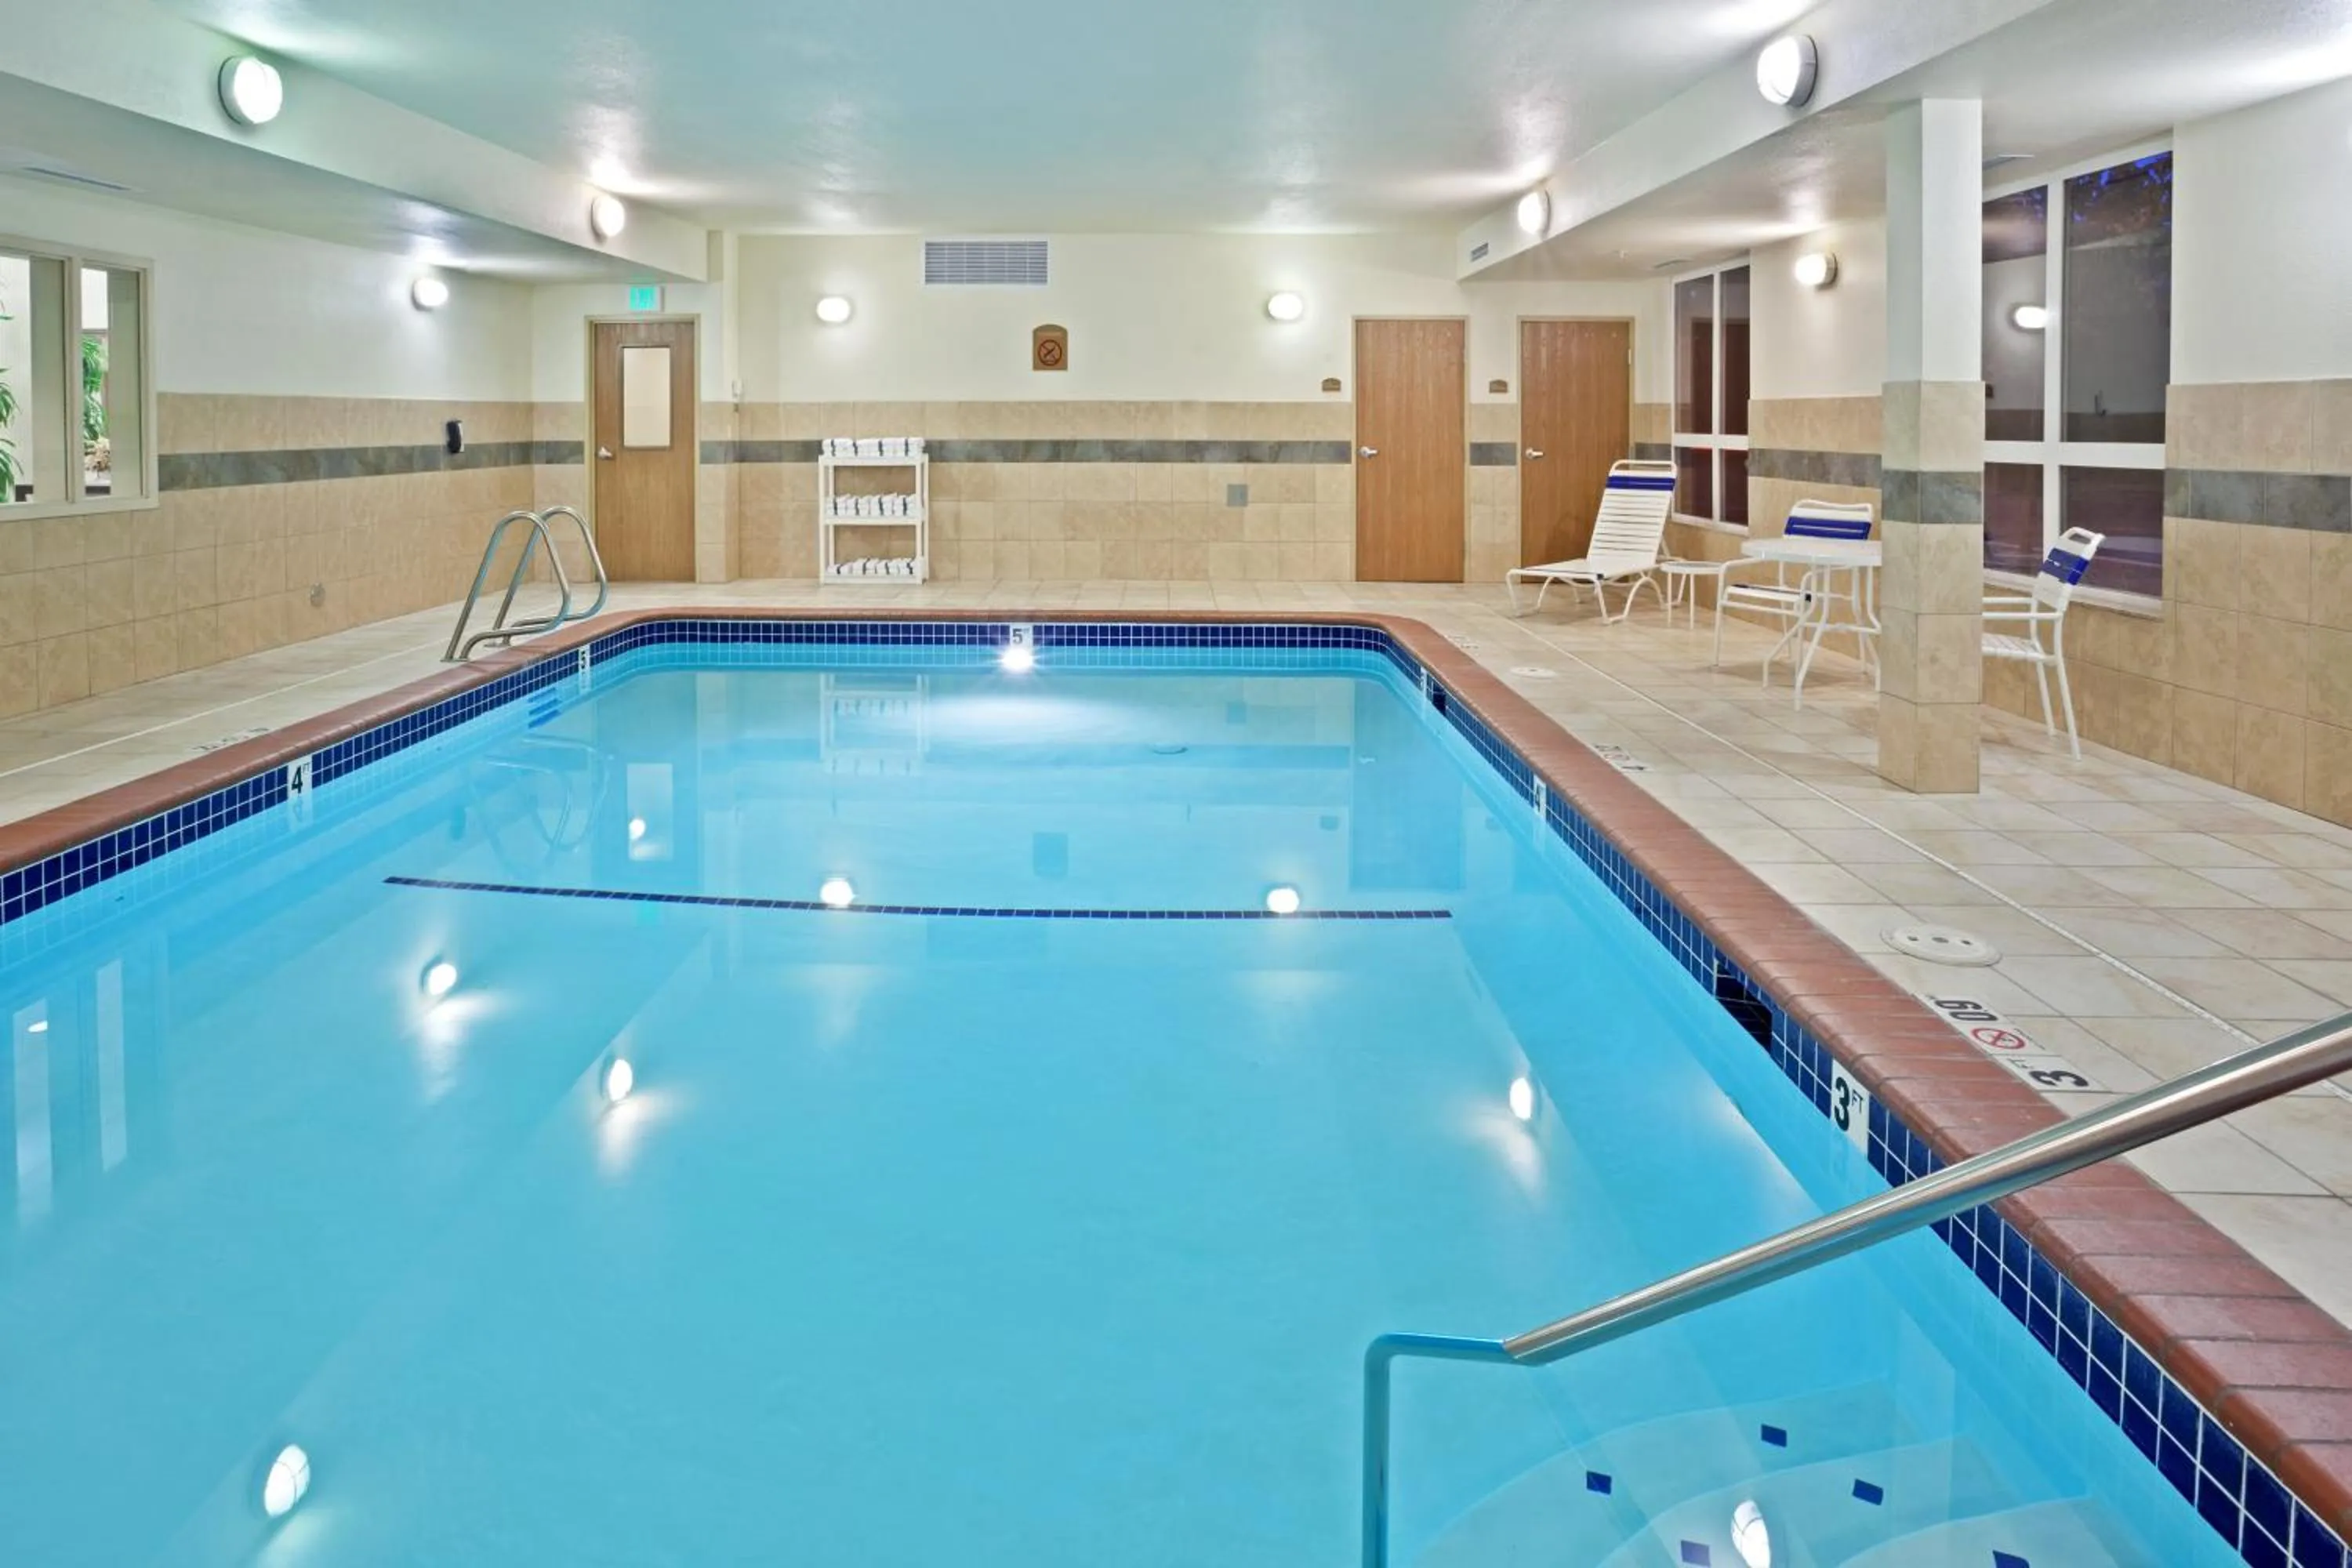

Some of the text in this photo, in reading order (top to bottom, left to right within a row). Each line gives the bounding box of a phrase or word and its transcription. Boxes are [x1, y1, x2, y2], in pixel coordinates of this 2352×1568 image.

[1012, 628, 1022, 644] 5
[291, 765, 303, 794] 4
[2029, 1071, 2089, 1087] 3
[1835, 1076, 1863, 1131] 3 FT
